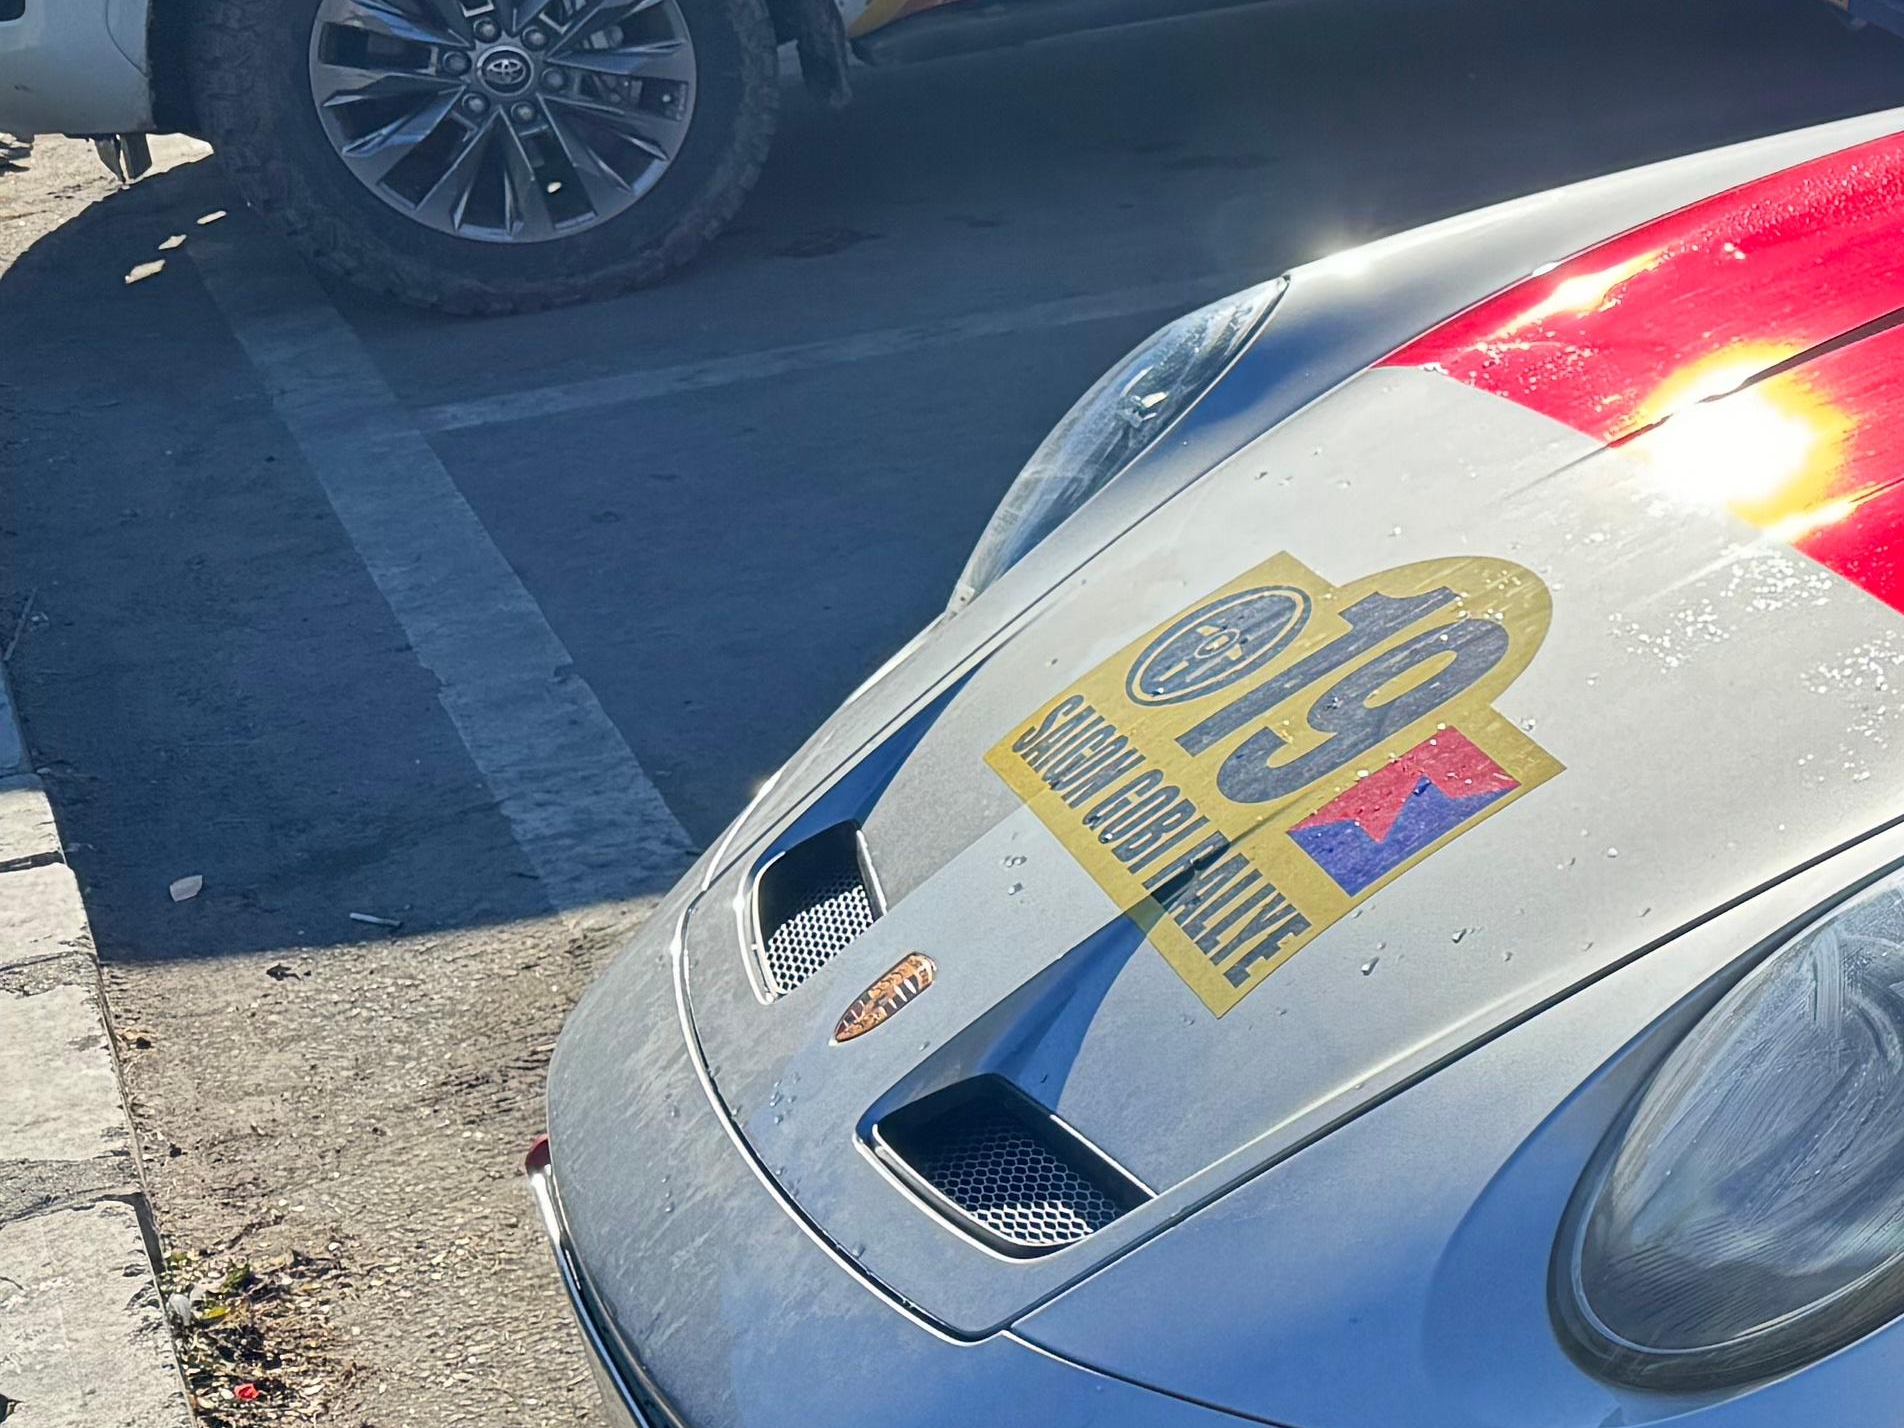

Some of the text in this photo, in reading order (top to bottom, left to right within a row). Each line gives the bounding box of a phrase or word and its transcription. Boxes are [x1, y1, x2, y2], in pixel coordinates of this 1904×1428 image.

[1174, 586, 1510, 805] 19
[1011, 694, 1312, 990] SAIGON GOBI RALLYE
